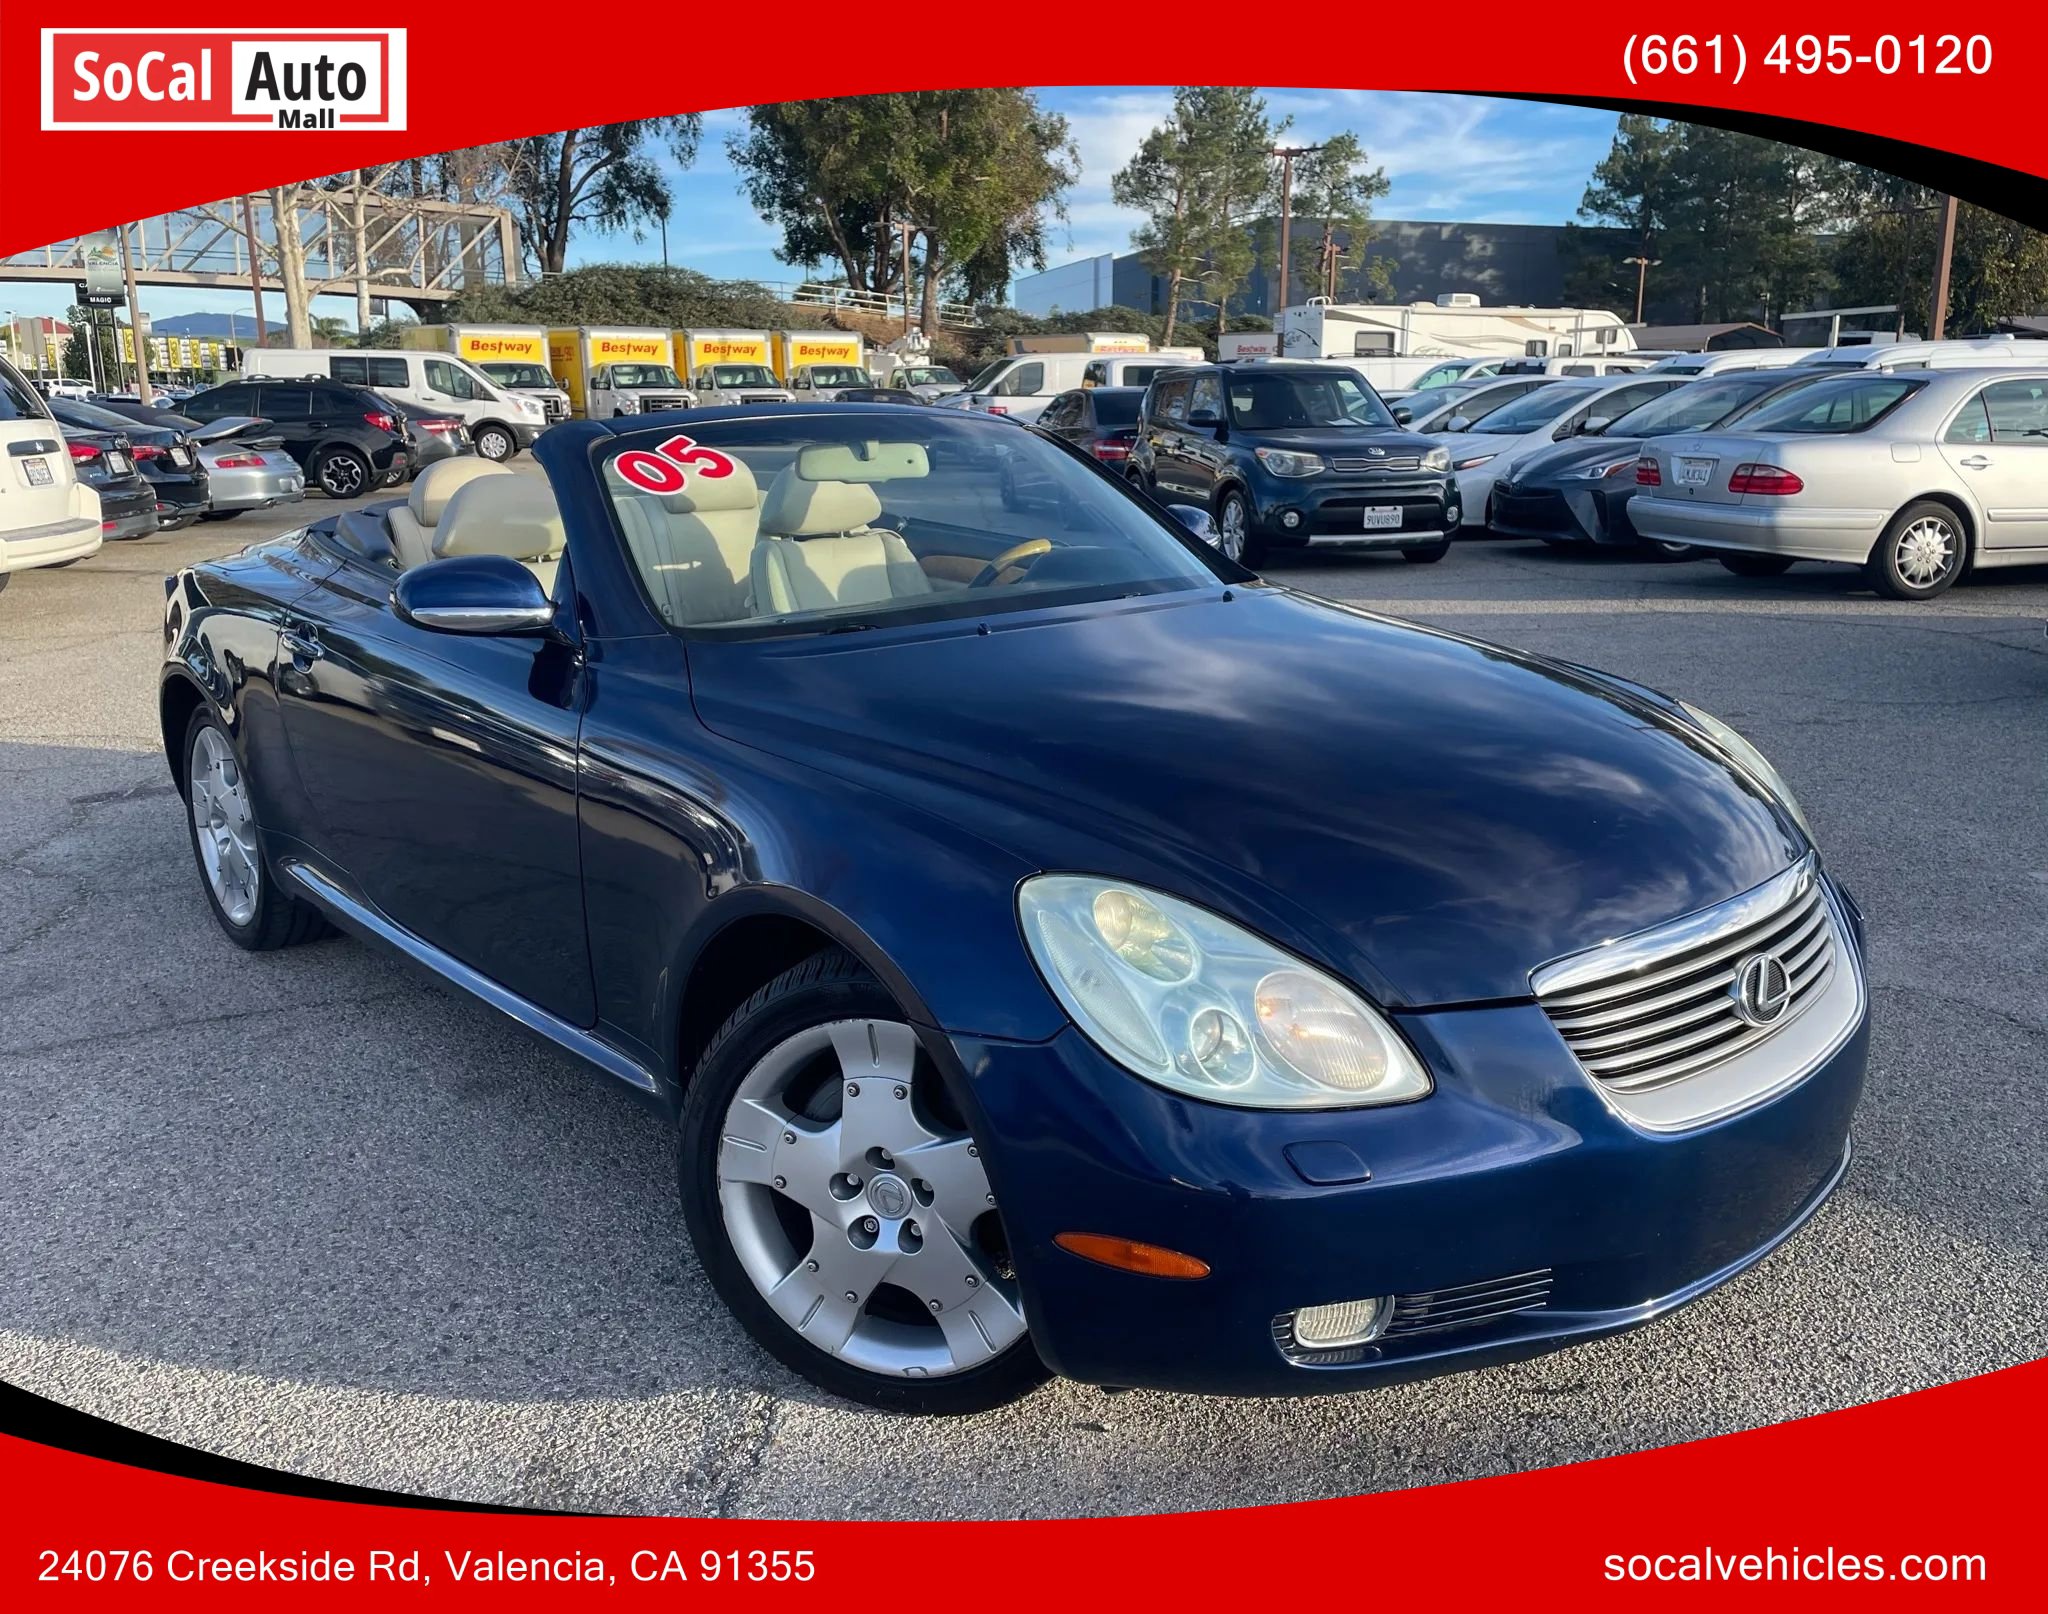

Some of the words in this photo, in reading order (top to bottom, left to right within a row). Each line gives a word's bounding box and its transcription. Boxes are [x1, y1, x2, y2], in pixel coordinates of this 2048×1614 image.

[470, 340, 532, 354] Bestway
[601, 342, 659, 355] Bestway
[703, 343, 757, 356] Bestway
[799, 345, 850, 358] Bestway
[1236, 344, 1267, 353] Bestway
[613, 434, 736, 495] 05
